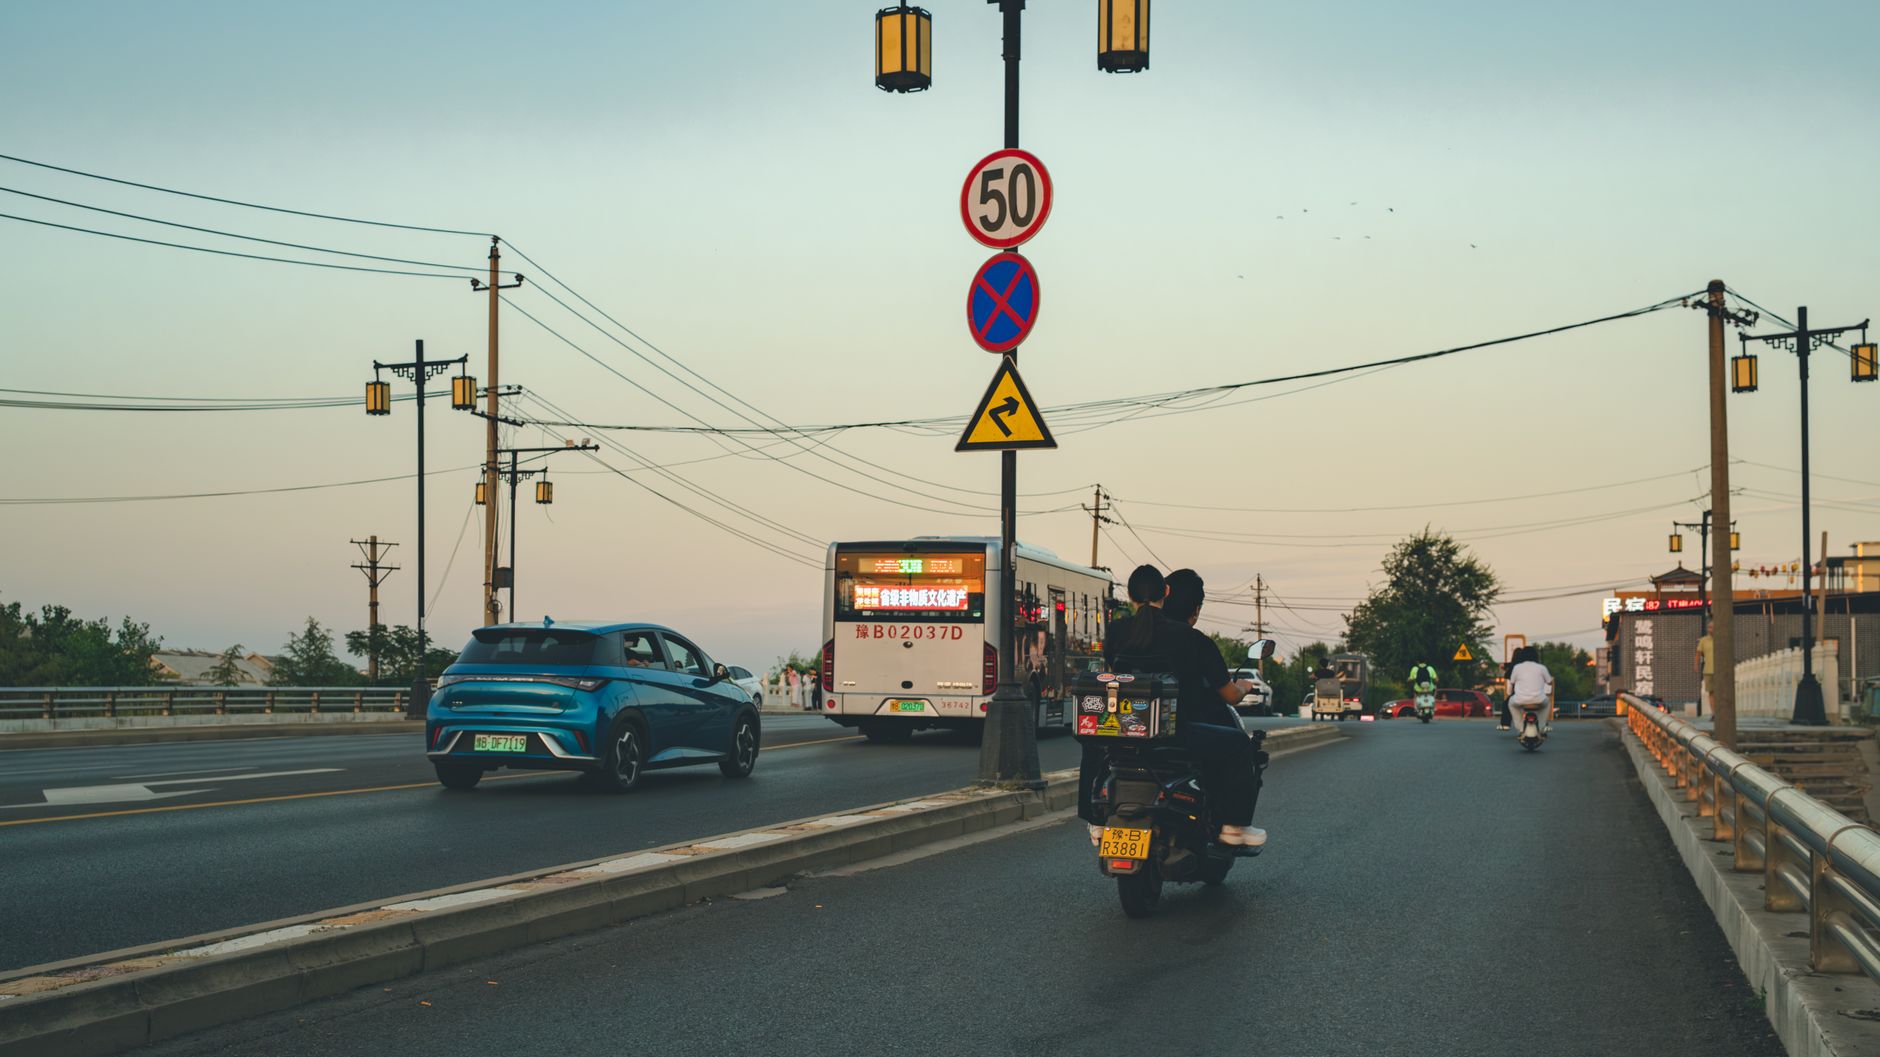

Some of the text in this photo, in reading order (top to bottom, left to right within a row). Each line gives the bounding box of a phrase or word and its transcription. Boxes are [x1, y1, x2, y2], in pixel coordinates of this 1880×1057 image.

[979, 163, 1036, 232] 50
[880, 588, 966, 607] 省级非物质文化遗产
[855, 624, 963, 640] 豫B02037D
[1102, 841, 1144, 857] R3881
